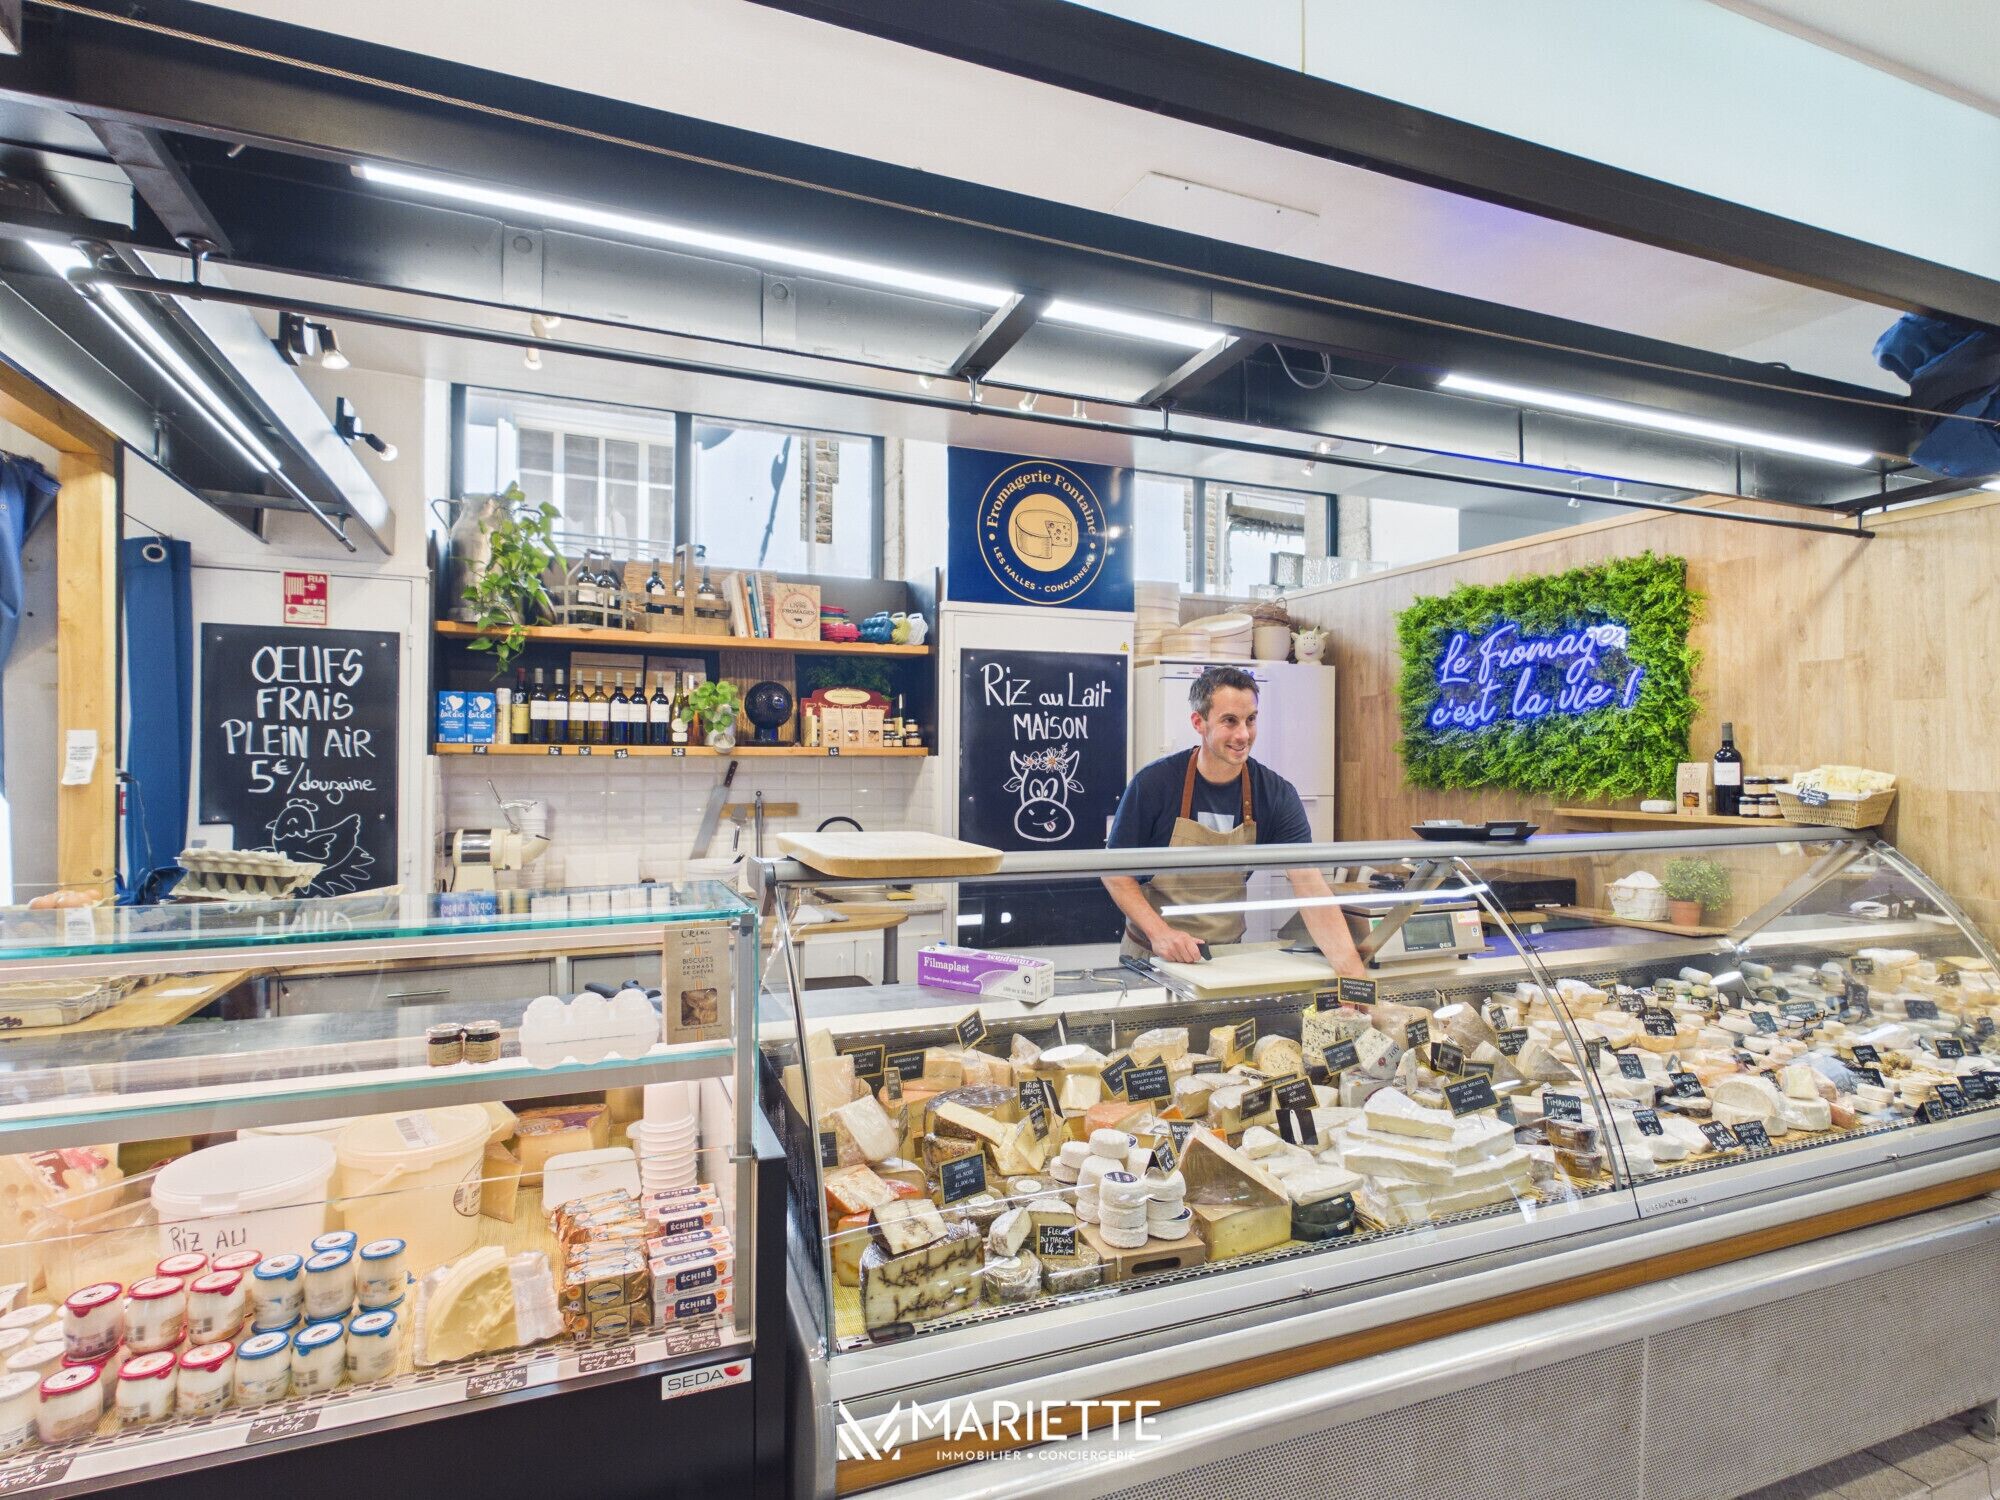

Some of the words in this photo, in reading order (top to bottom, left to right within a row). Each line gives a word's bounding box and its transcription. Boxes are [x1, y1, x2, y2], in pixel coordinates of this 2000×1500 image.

[986, 470, 1052, 528] Fromagerie
[1054, 474, 1097, 534] Fontaine
[307, 575, 326, 583] RIA
[993, 546, 1006, 565] LES
[1004, 564, 1036, 591] HALLES
[1044, 554, 1096, 593] CONCARNEAU
[1440, 634, 1472, 684] Le
[1478, 623, 1622, 684] Fromage
[980, 662, 1032, 706] Riz
[1039, 693, 1064, 706] au
[1068, 672, 1112, 707] Lait
[1432, 678, 1502, 726] c'est
[1512, 667, 1551, 717] la
[1559, 677, 1613, 711] vie
[682, 956, 713, 964] BISCUITS
[923, 956, 970, 973] Filmaplast
[671, 1218, 700, 1230] ÉCHIRÉ
[680, 1268, 713, 1283] ÉCHIRÉ
[679, 1297, 713, 1312] ÉCHIRÉ
[668, 1369, 724, 1391] SEDA
